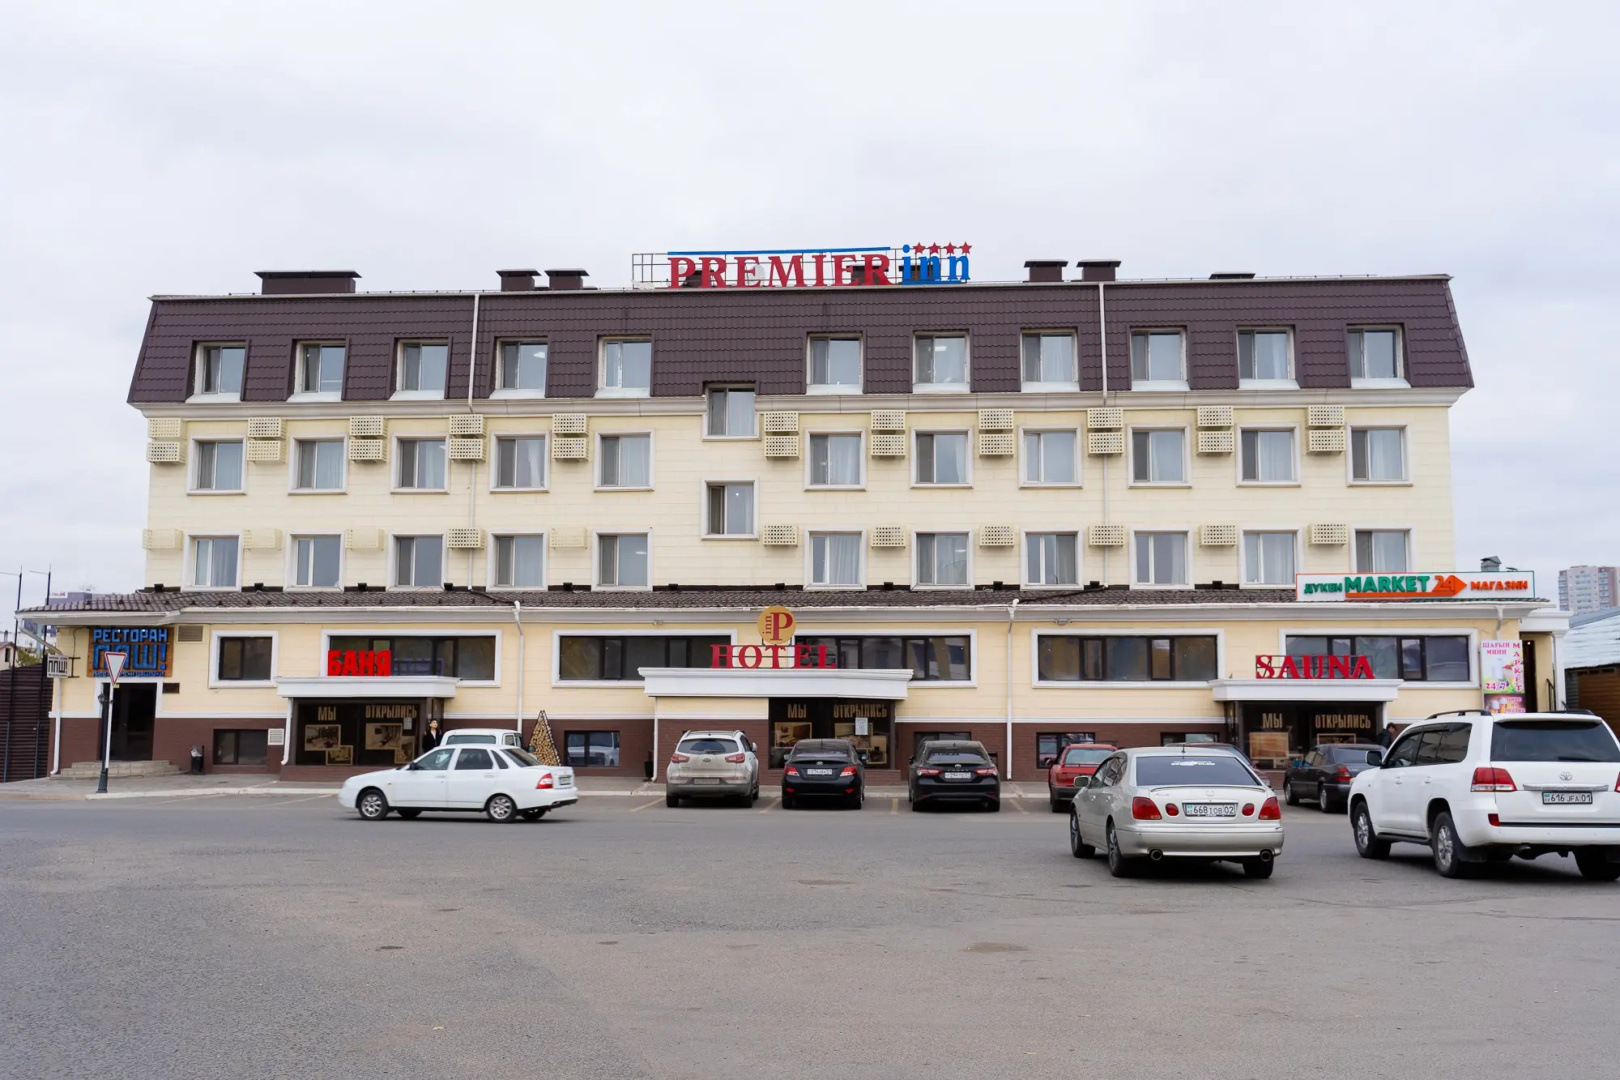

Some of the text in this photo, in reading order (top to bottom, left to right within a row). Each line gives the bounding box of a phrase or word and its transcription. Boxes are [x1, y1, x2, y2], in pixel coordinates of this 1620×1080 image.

[669, 244, 971, 288] PREMIER inn
[1345, 576, 1430, 593] MARKET
[1433, 575, 1456, 592] 24
[1470, 581, 1529, 591] МАГАЗИН
[770, 612, 793, 640] P
[93, 628, 168, 642] РЕСТОРАН
[328, 650, 391, 676] БАНЯ
[710, 644, 836, 669] HOTEL
[1256, 655, 1376, 679] SAUNA
[318, 705, 417, 721] МЫ ОТКРЫЛИСЬ
[787, 704, 887, 719] МЫ ОТКРЫЛИСЬ
[1262, 713, 1371, 729] МЫ ОТКРЫЛИСЬ
[1551, 794, 1565, 802] 616
[1581, 794, 1591, 802] 01
[1194, 805, 1208, 814] 668
[1224, 806, 1234, 814] 02
